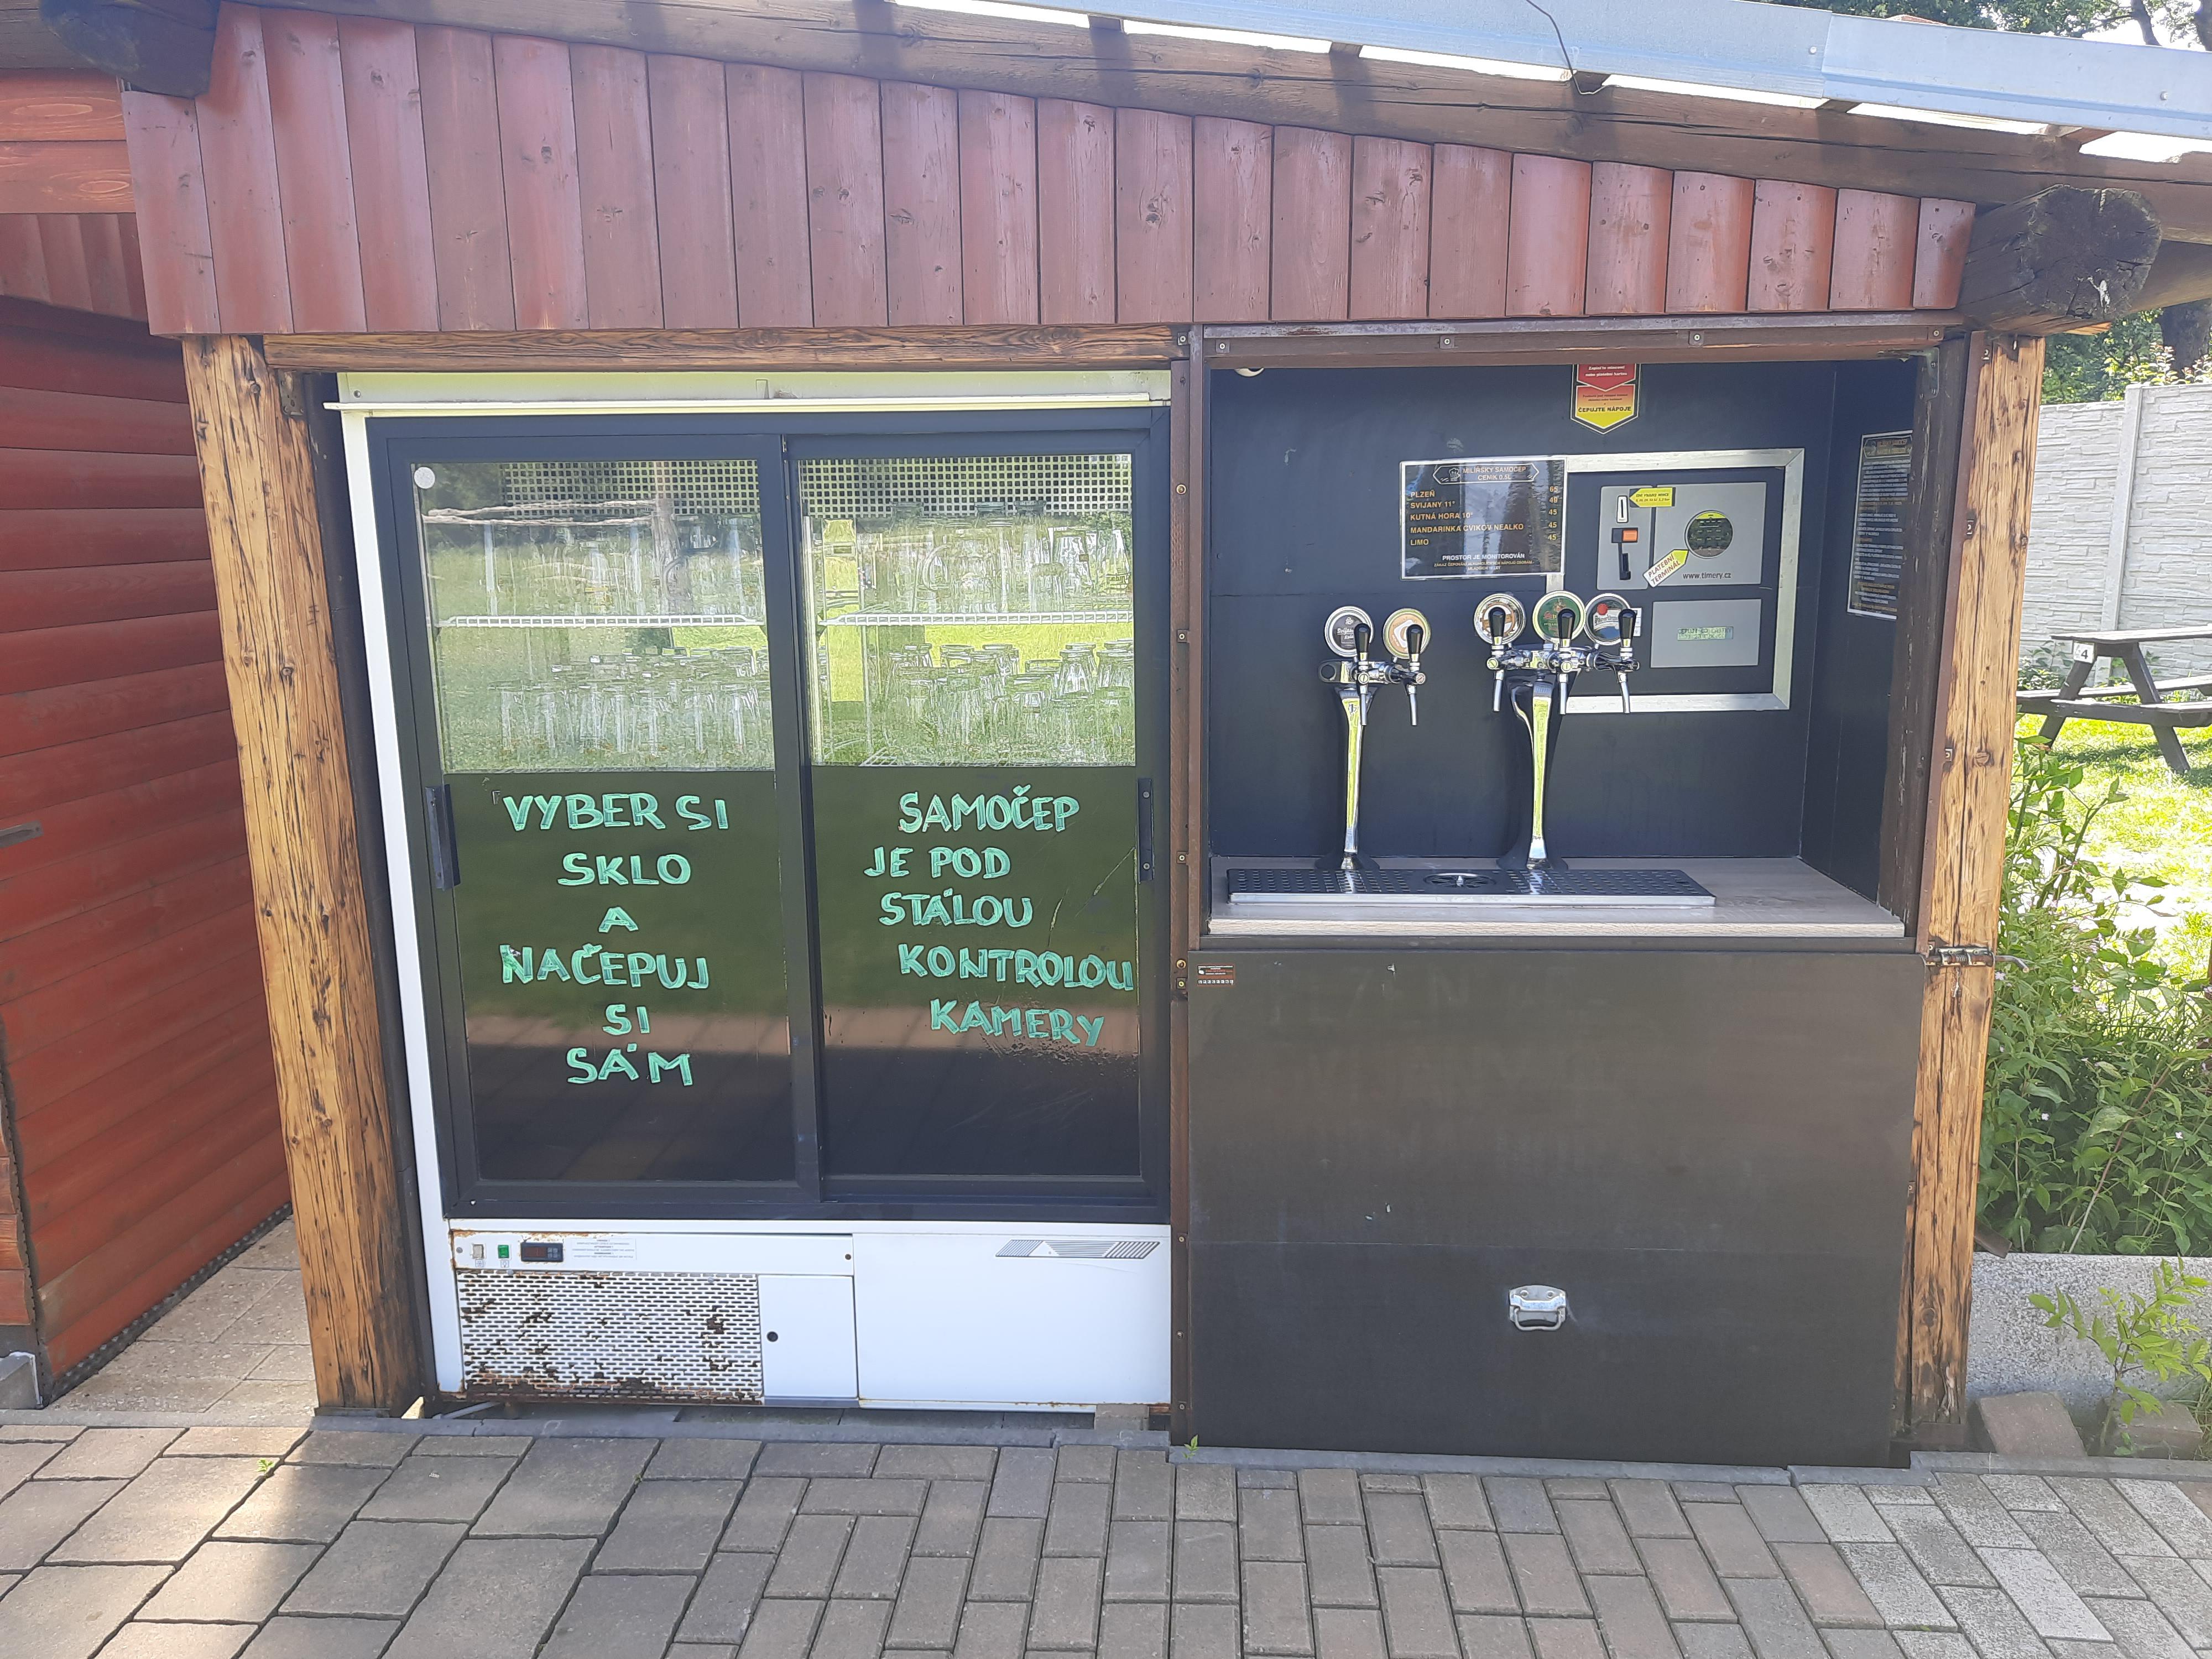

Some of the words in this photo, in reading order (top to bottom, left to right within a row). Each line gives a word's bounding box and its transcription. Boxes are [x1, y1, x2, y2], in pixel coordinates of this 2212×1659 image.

[1410, 489, 1435, 498] PLZEŇ
[1410, 512, 1436, 521] KUTNÁ
[1410, 525, 1461, 534] MANDARINKA
[1648, 553, 1674, 578] PLATEBNÍ
[1650, 560, 1681, 585] TERMINÁL
[2081, 649, 2089, 660] 4
[503, 792, 666, 831] VYBER
[674, 795, 729, 831] SI
[898, 784, 1080, 833] SAMOČEP
[557, 852, 692, 886] SKLO
[863, 847, 914, 878] JE
[928, 847, 1011, 879] POD
[598, 906, 639, 933] A
[879, 888, 1034, 927] STÁLOU
[499, 942, 710, 989] NAČEPUJ
[897, 943, 1134, 991] KONTROLOU
[602, 1004, 650, 1036] SI
[930, 998, 1105, 1047] KAMERY
[566, 1043, 693, 1086] SÁM
